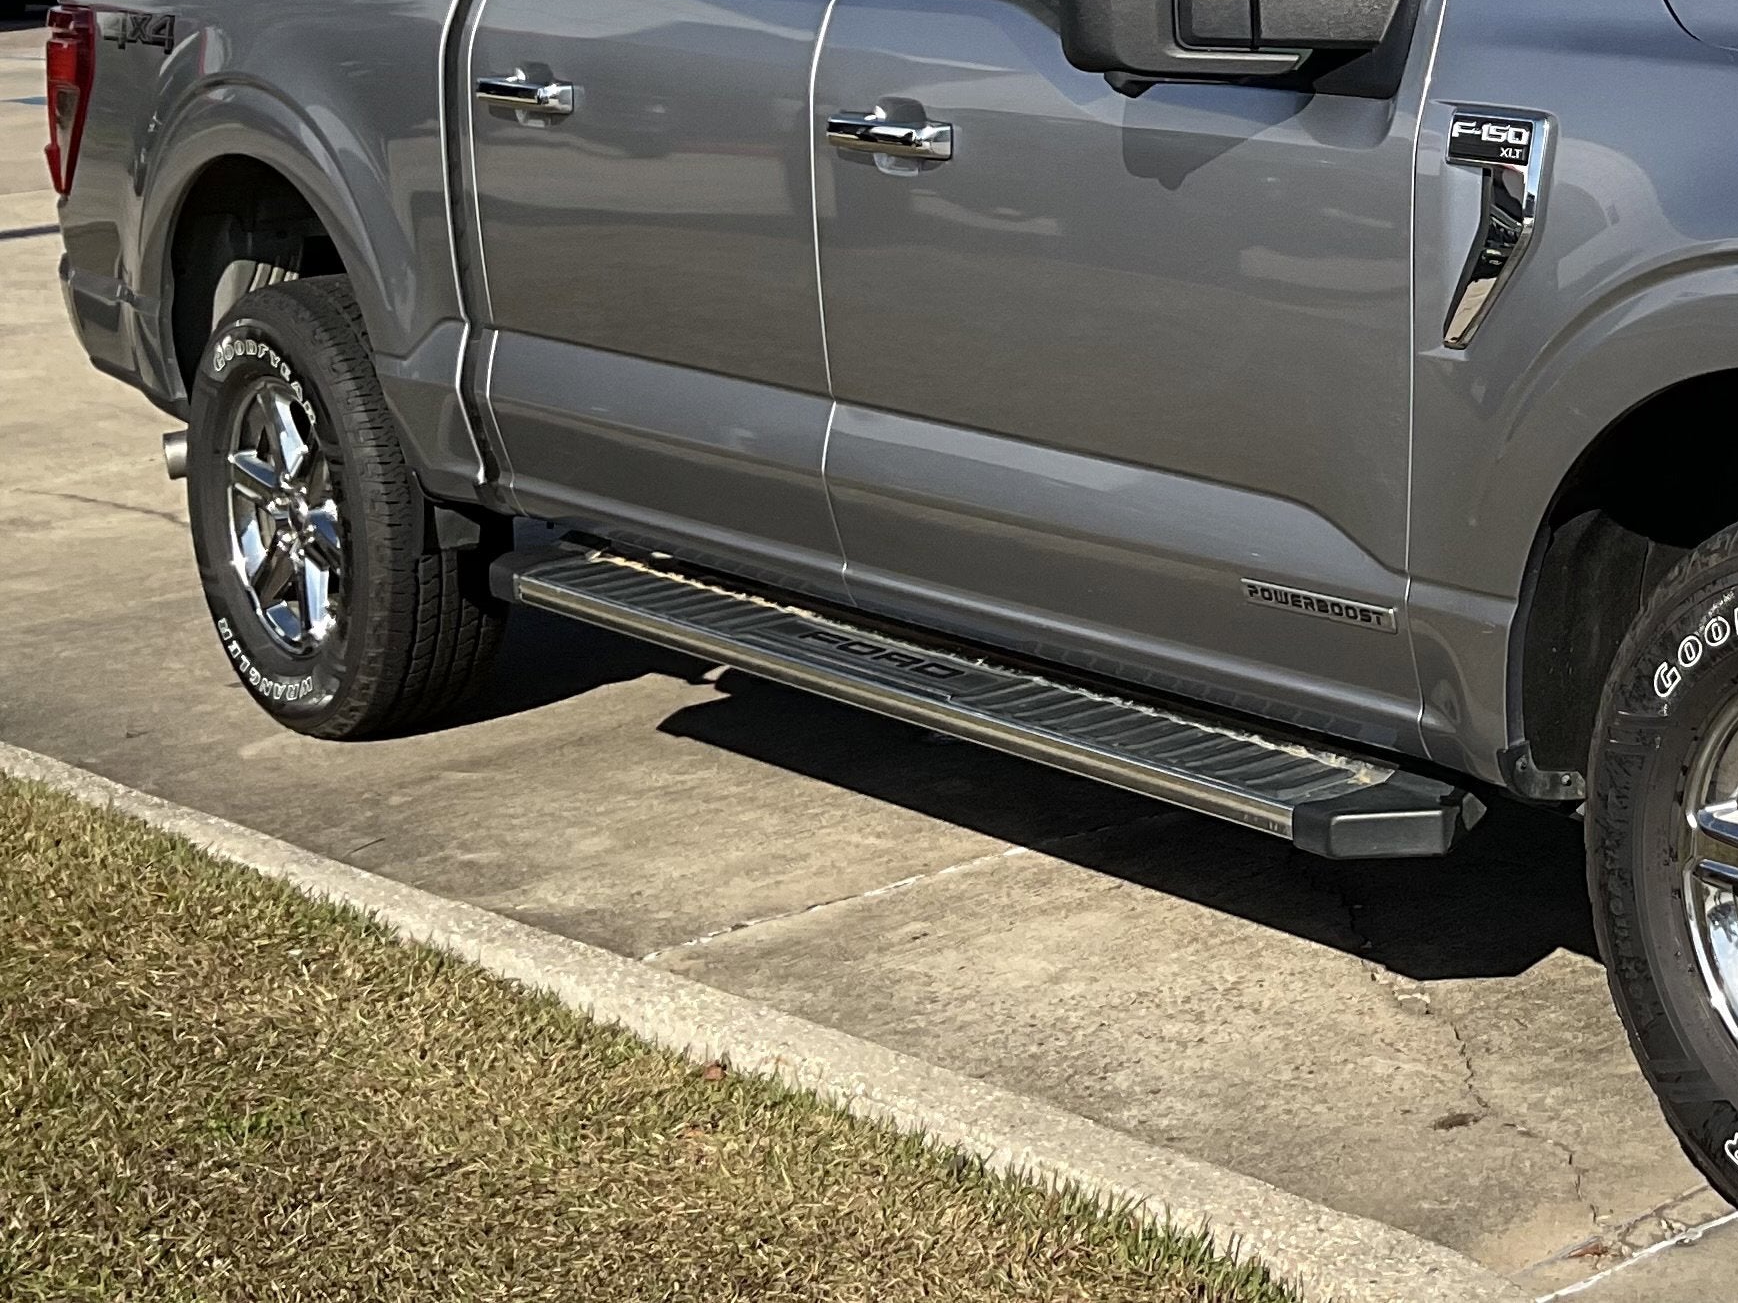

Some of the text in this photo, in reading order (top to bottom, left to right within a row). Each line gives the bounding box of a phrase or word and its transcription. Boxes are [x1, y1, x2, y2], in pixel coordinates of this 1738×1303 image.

[1452, 121, 1530, 145] F-150
[1500, 147, 1522, 158] XLT
[213, 339, 317, 426] GOODYEAR
[1247, 584, 1384, 626] POWERBOOST
[217, 617, 314, 701] WRANGLER
[798, 631, 966, 679] FORD
